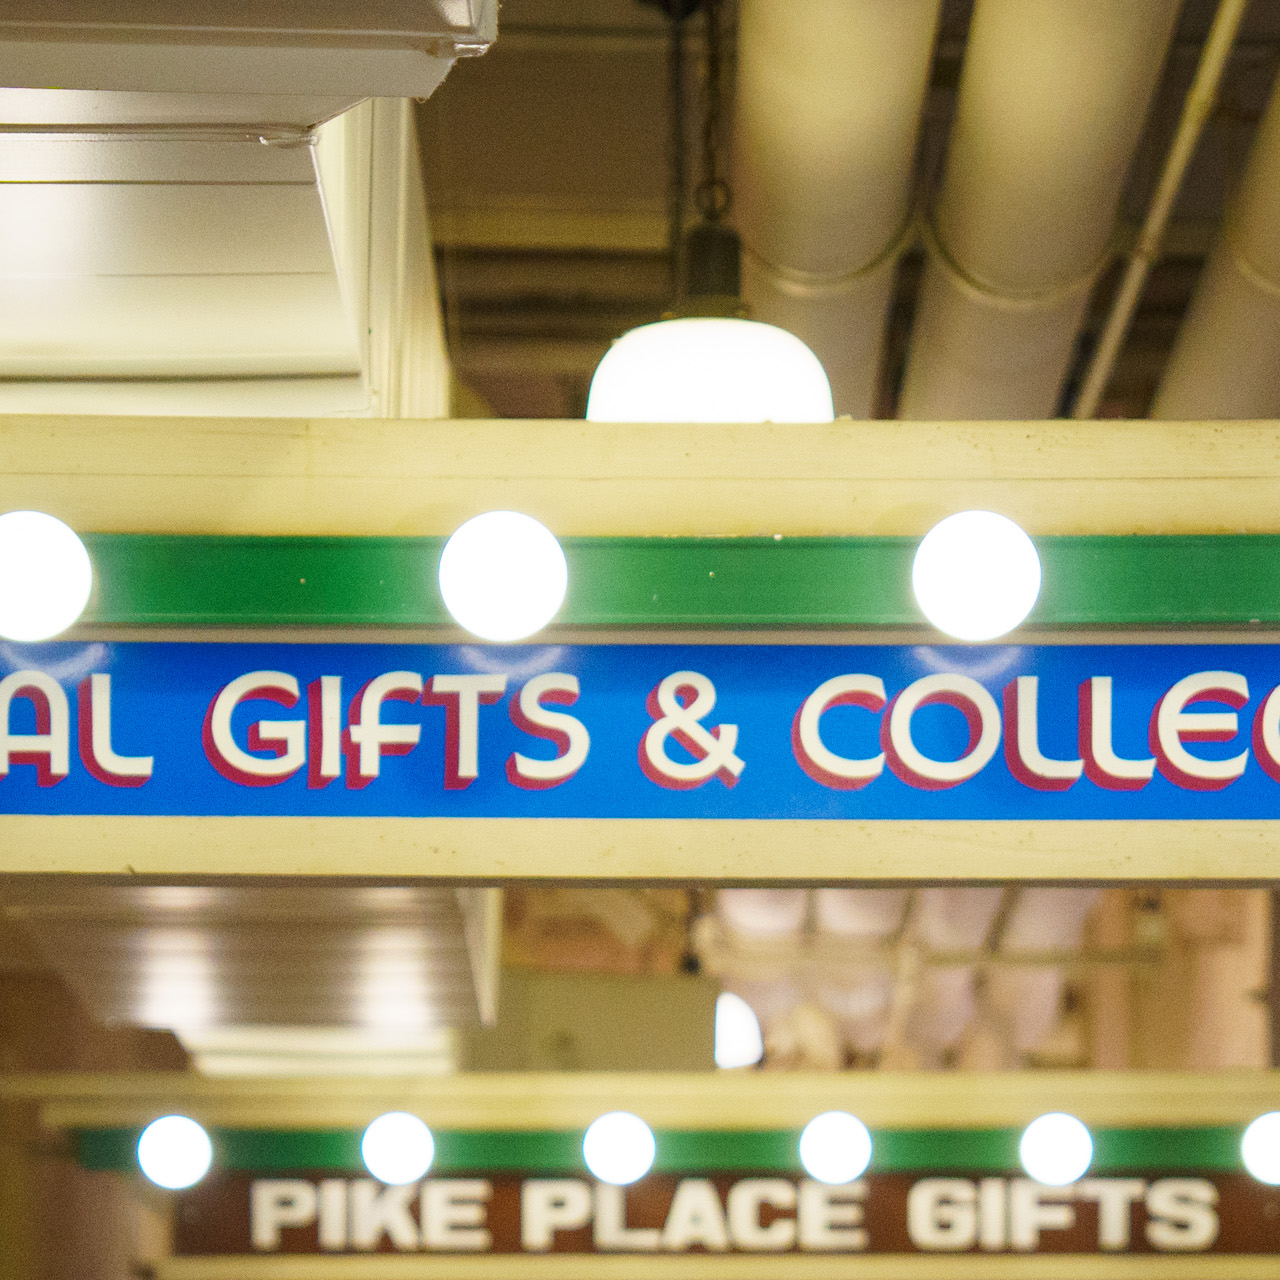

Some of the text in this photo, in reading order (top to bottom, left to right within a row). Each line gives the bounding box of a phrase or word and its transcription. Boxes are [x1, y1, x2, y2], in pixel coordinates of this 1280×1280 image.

[201, 670, 590, 790] GIFTS
[638, 669, 746, 791] &
[250, 1176, 1219, 1252] PIKE PLACE GIFTS
